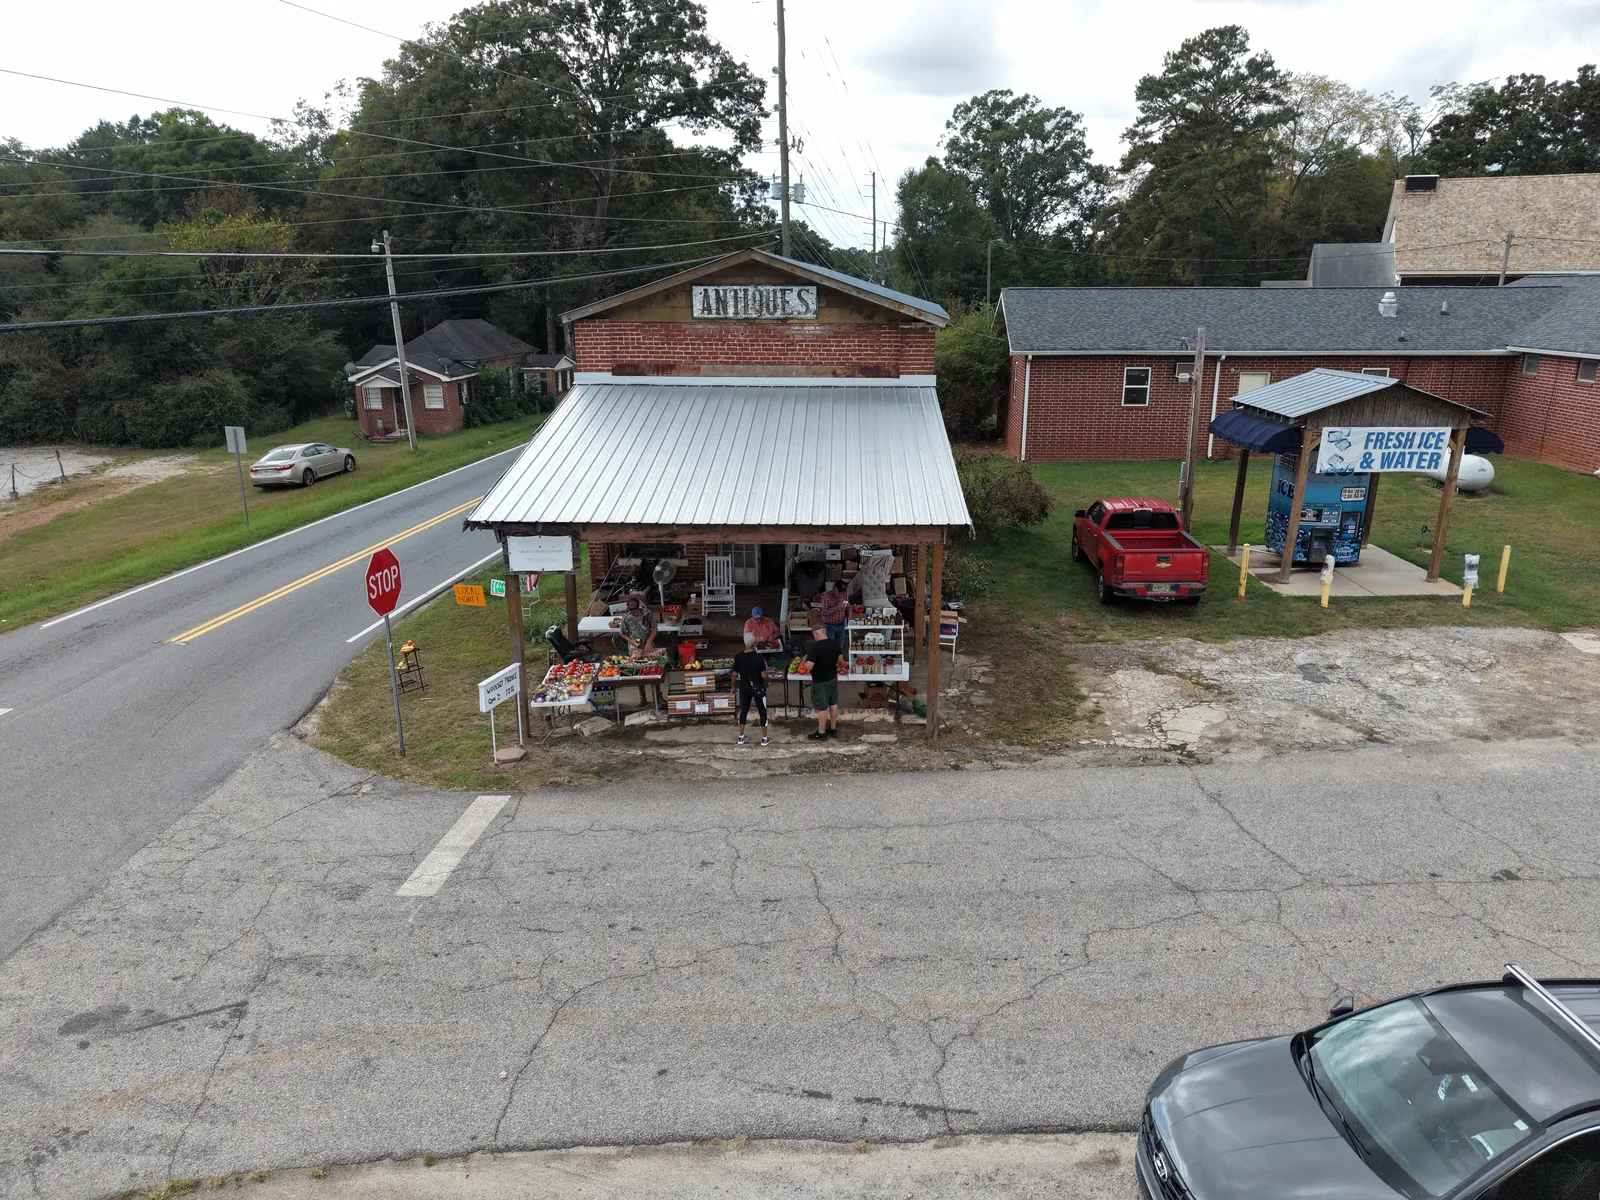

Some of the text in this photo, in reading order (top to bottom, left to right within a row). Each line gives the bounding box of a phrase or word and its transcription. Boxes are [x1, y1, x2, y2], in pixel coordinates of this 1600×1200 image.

[700, 288, 810, 316] ANTIQUES
[1363, 431, 1446, 450] FRESH ICE
[1360, 451, 1441, 470] & WATER
[369, 565, 399, 600] STOP
[456, 586, 480, 595] LOCAL
[492, 580, 505, 594] EGGS
[458, 595, 480, 603] HONEY
